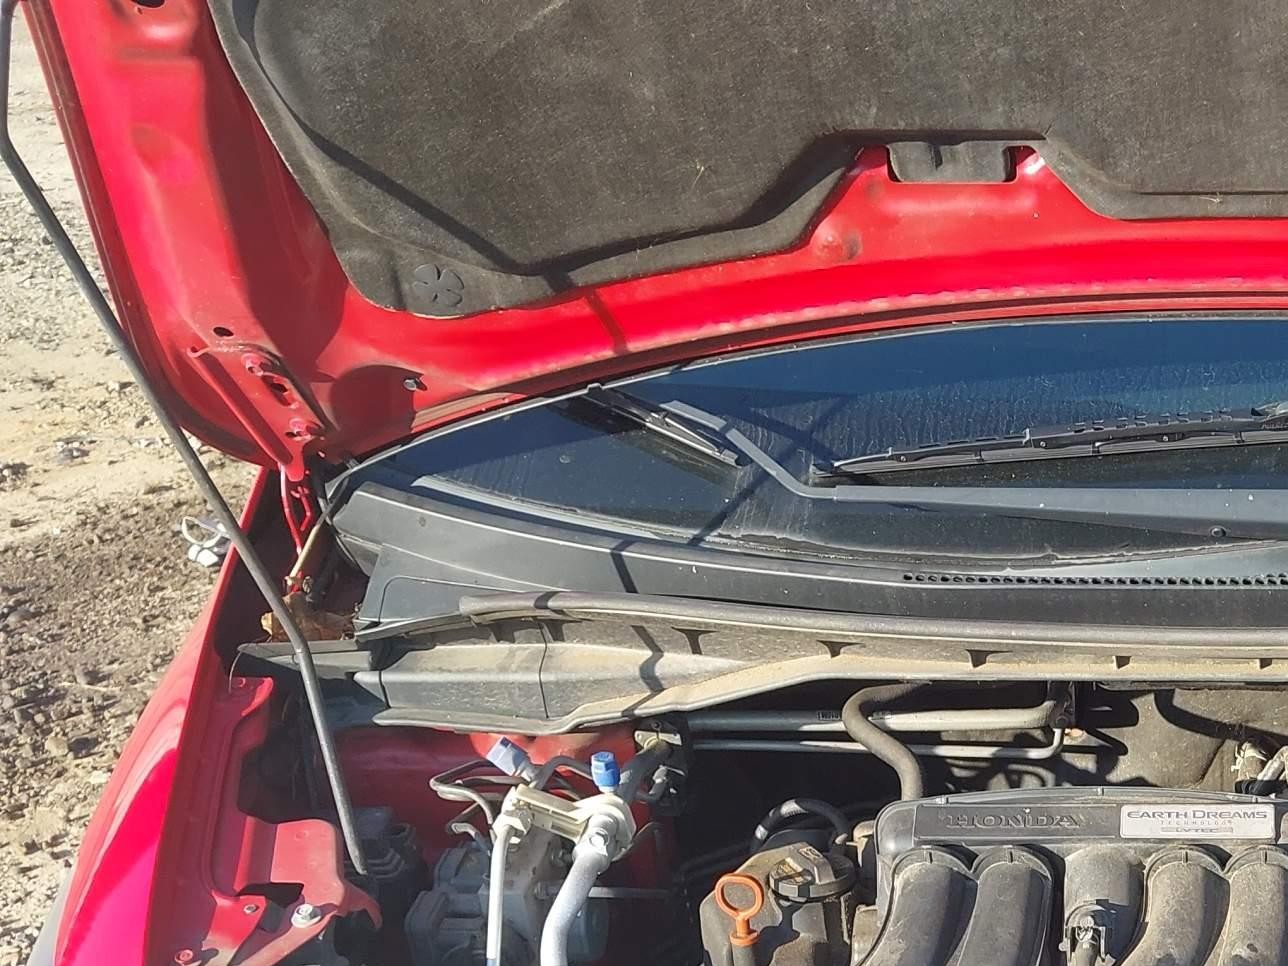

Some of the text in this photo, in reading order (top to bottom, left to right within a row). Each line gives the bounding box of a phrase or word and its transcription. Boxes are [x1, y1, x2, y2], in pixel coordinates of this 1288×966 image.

[1127, 809, 1268, 819] EARTH DREAMS
[946, 813, 1080, 829] HONDA
